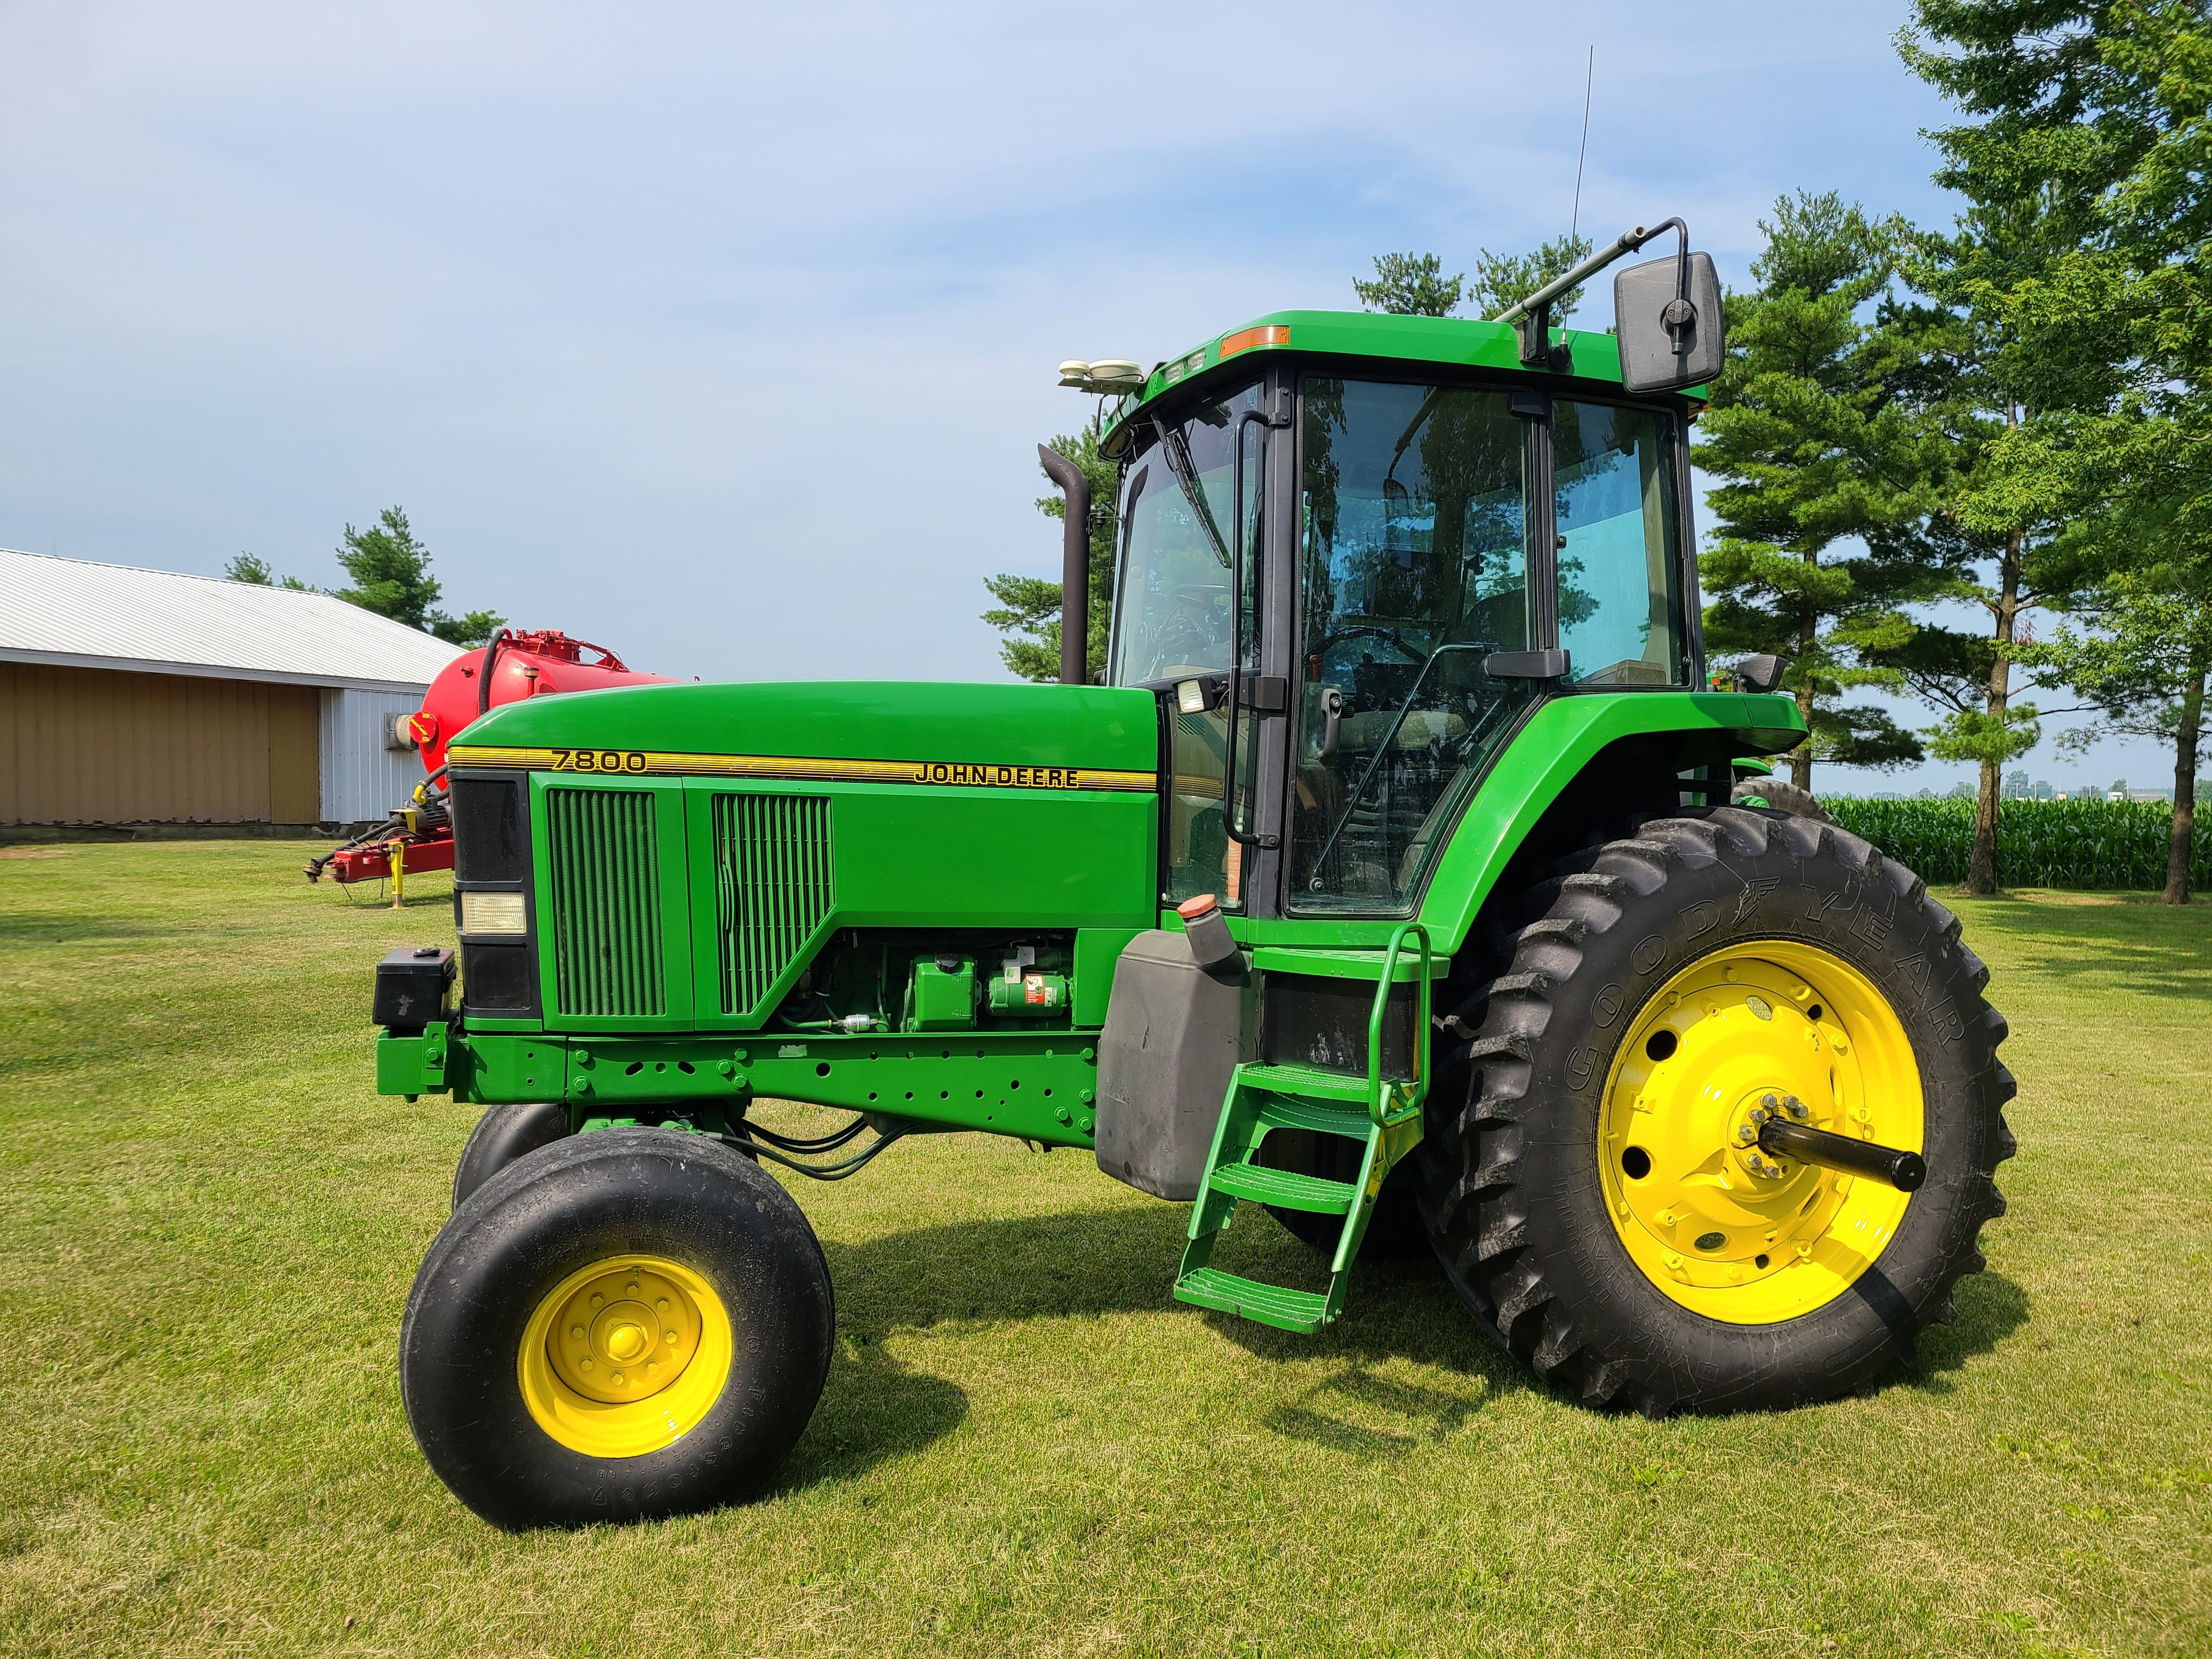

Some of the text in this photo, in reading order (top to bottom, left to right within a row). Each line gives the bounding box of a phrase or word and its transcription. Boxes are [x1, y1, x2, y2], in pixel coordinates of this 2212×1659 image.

[550, 751, 647, 773] 7800
[915, 764, 1079, 788] JOHN DEERE
[1551, 1156, 1720, 1383] DYNA TORQUE
[1582, 1209, 1674, 1342] RADIAL
[707, 1381, 743, 1435] CHAMPION
[621, 1386, 766, 1502] Firestone
[595, 1470, 617, 1479] RIB
[624, 1469, 633, 1479] 4
[639, 1459, 668, 1476] GRIP
